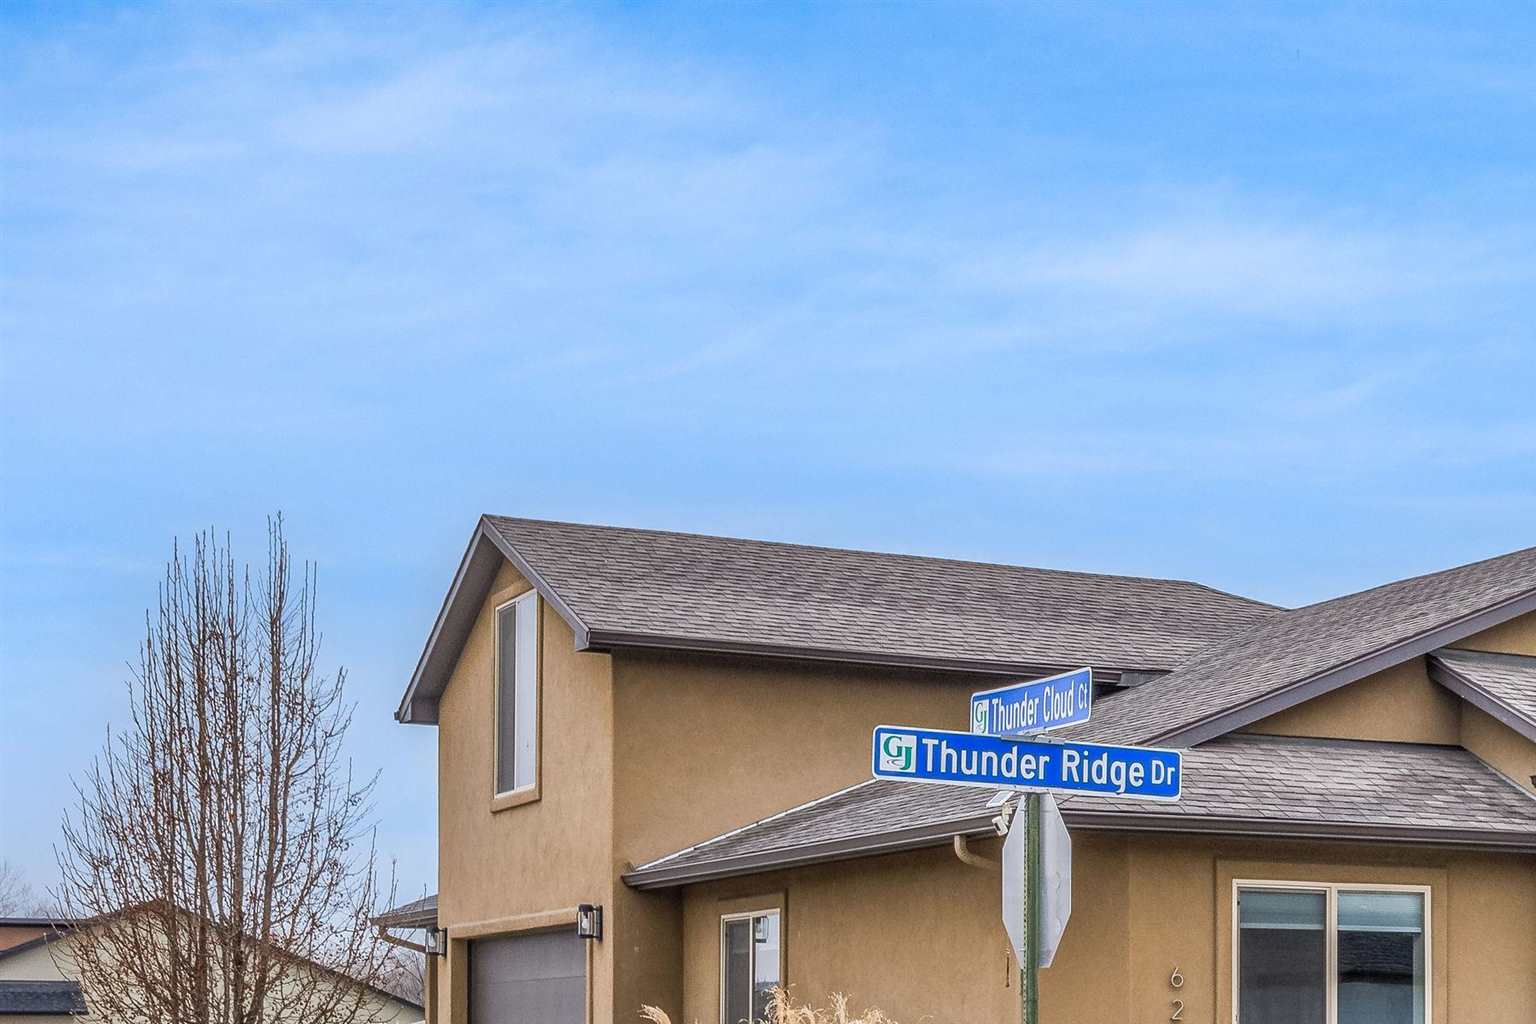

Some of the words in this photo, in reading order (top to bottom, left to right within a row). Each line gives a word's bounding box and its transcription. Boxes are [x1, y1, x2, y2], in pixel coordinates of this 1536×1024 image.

[992, 691, 1040, 733] Thunder
[1043, 678, 1074, 722] Cloud
[1078, 682, 1088, 709] Ct
[922, 738, 1050, 780] Thunder
[1061, 749, 1145, 793] Ridge
[1151, 759, 1176, 785] Dr
